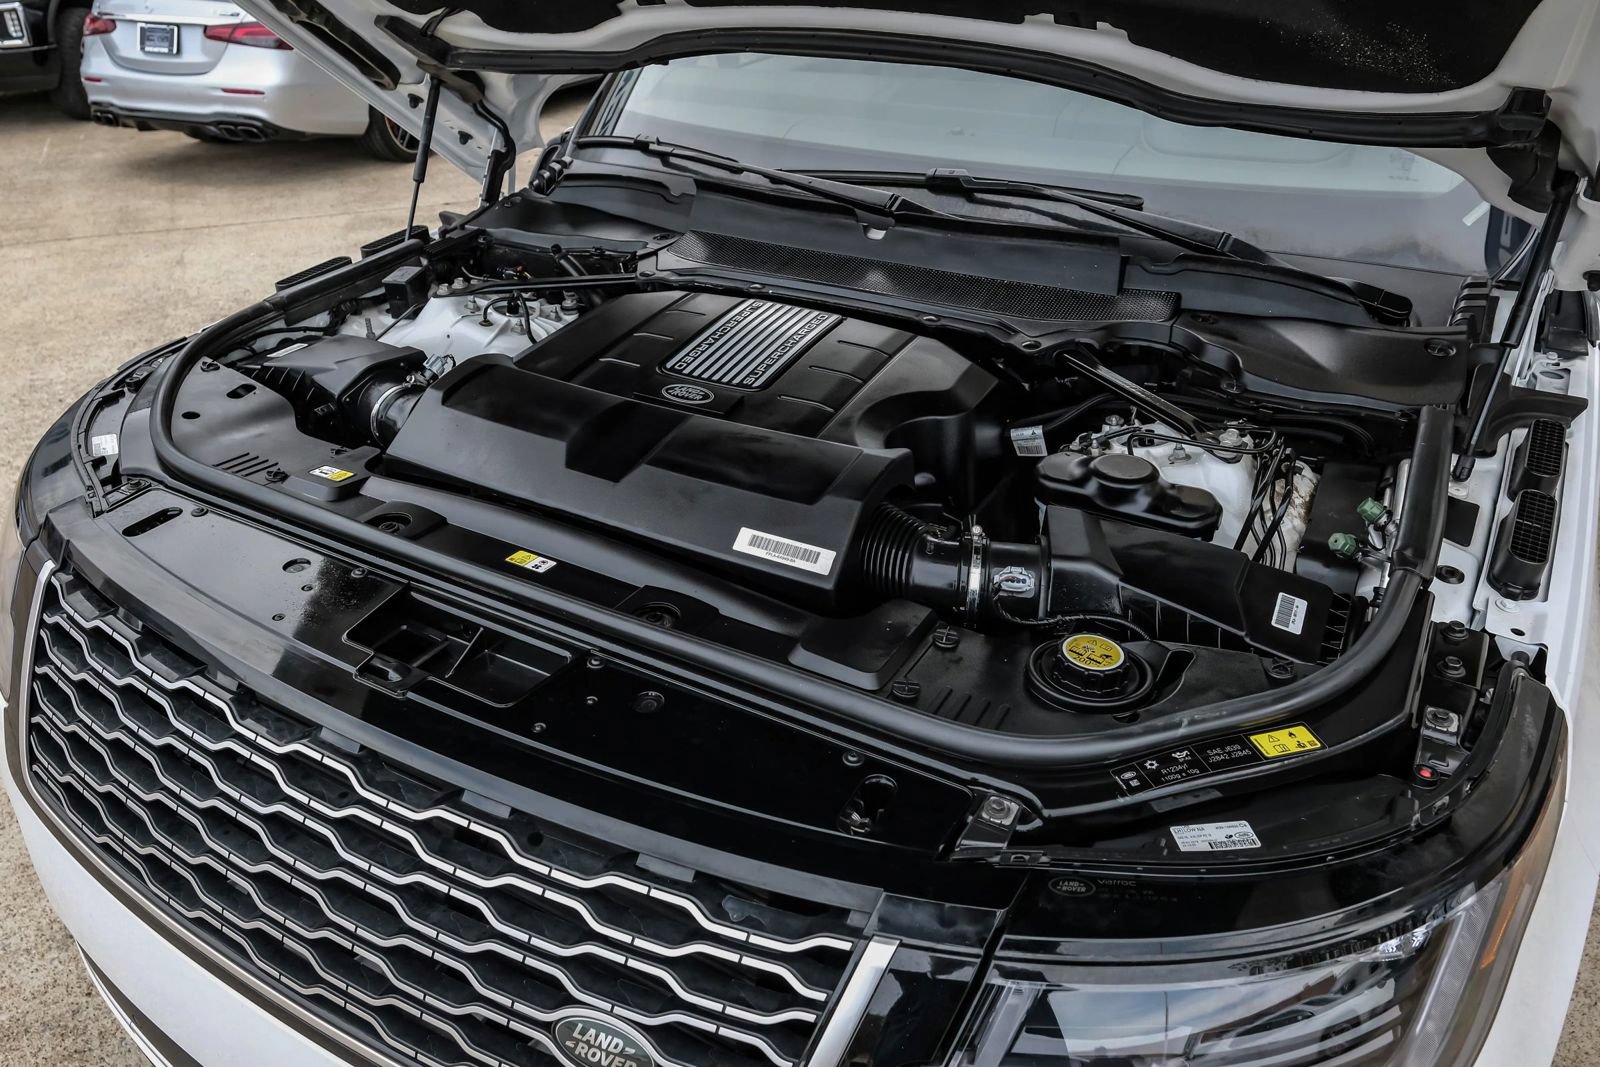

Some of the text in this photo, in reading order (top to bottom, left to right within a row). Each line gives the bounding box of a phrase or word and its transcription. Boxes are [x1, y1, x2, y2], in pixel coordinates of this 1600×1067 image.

[674, 301, 763, 370] SUPERCHARGED
[743, 313, 828, 385] SUPERCHARGED
[671, 391, 703, 401] ROVER
[673, 386, 699, 395] LAND
[1071, 655, 1091, 665] 200
[1206, 744, 1241, 755] SAE J639
[1208, 749, 1252, 763] J2842 J2845
[1161, 763, 1189, 774] R1234yf
[1161, 774, 1181, 783] 1100g
[1187, 768, 1200, 776] 10g
[572, 1023, 624, 1054] LAND
